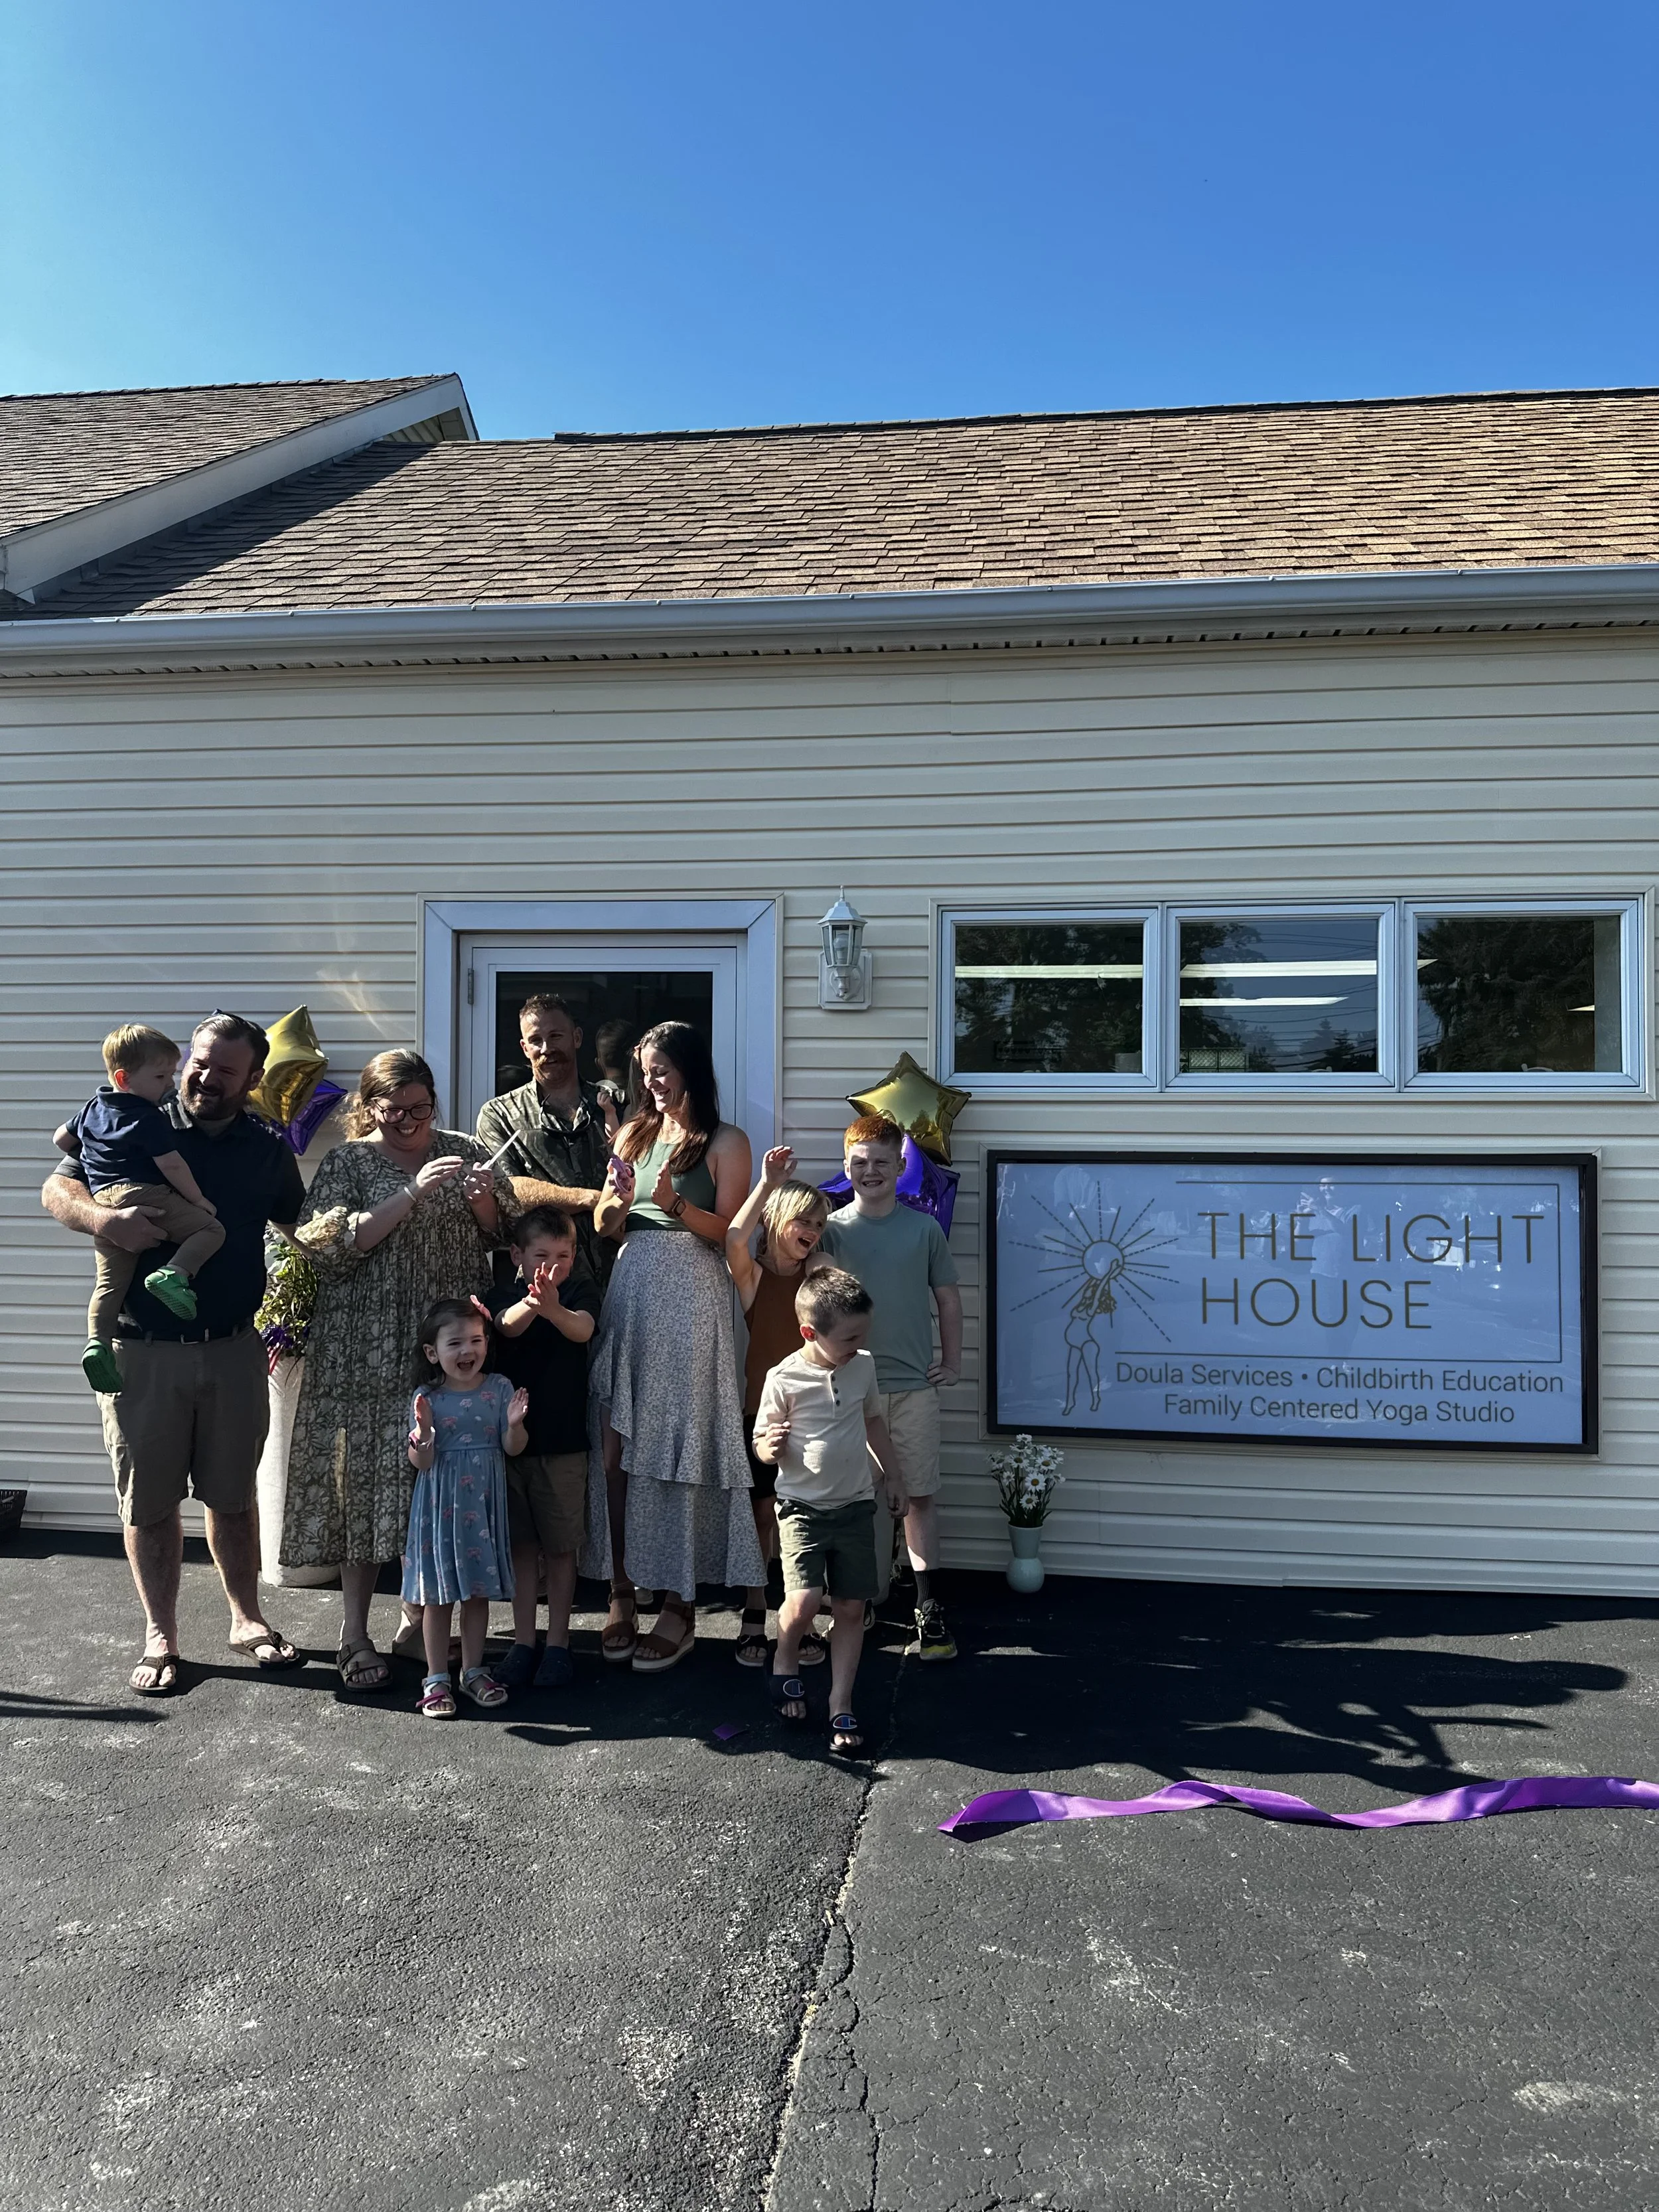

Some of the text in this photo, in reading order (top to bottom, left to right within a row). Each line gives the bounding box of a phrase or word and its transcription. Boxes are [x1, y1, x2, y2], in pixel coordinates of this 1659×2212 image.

[1197, 1213, 1544, 1264] THE LIGHT
[1202, 1277, 1432, 1329] HOUSE
[1116, 1362, 1563, 1392] Doula Services Childbirth Education
[1165, 1394, 1515, 1426] Family Centered Yoga Studio
